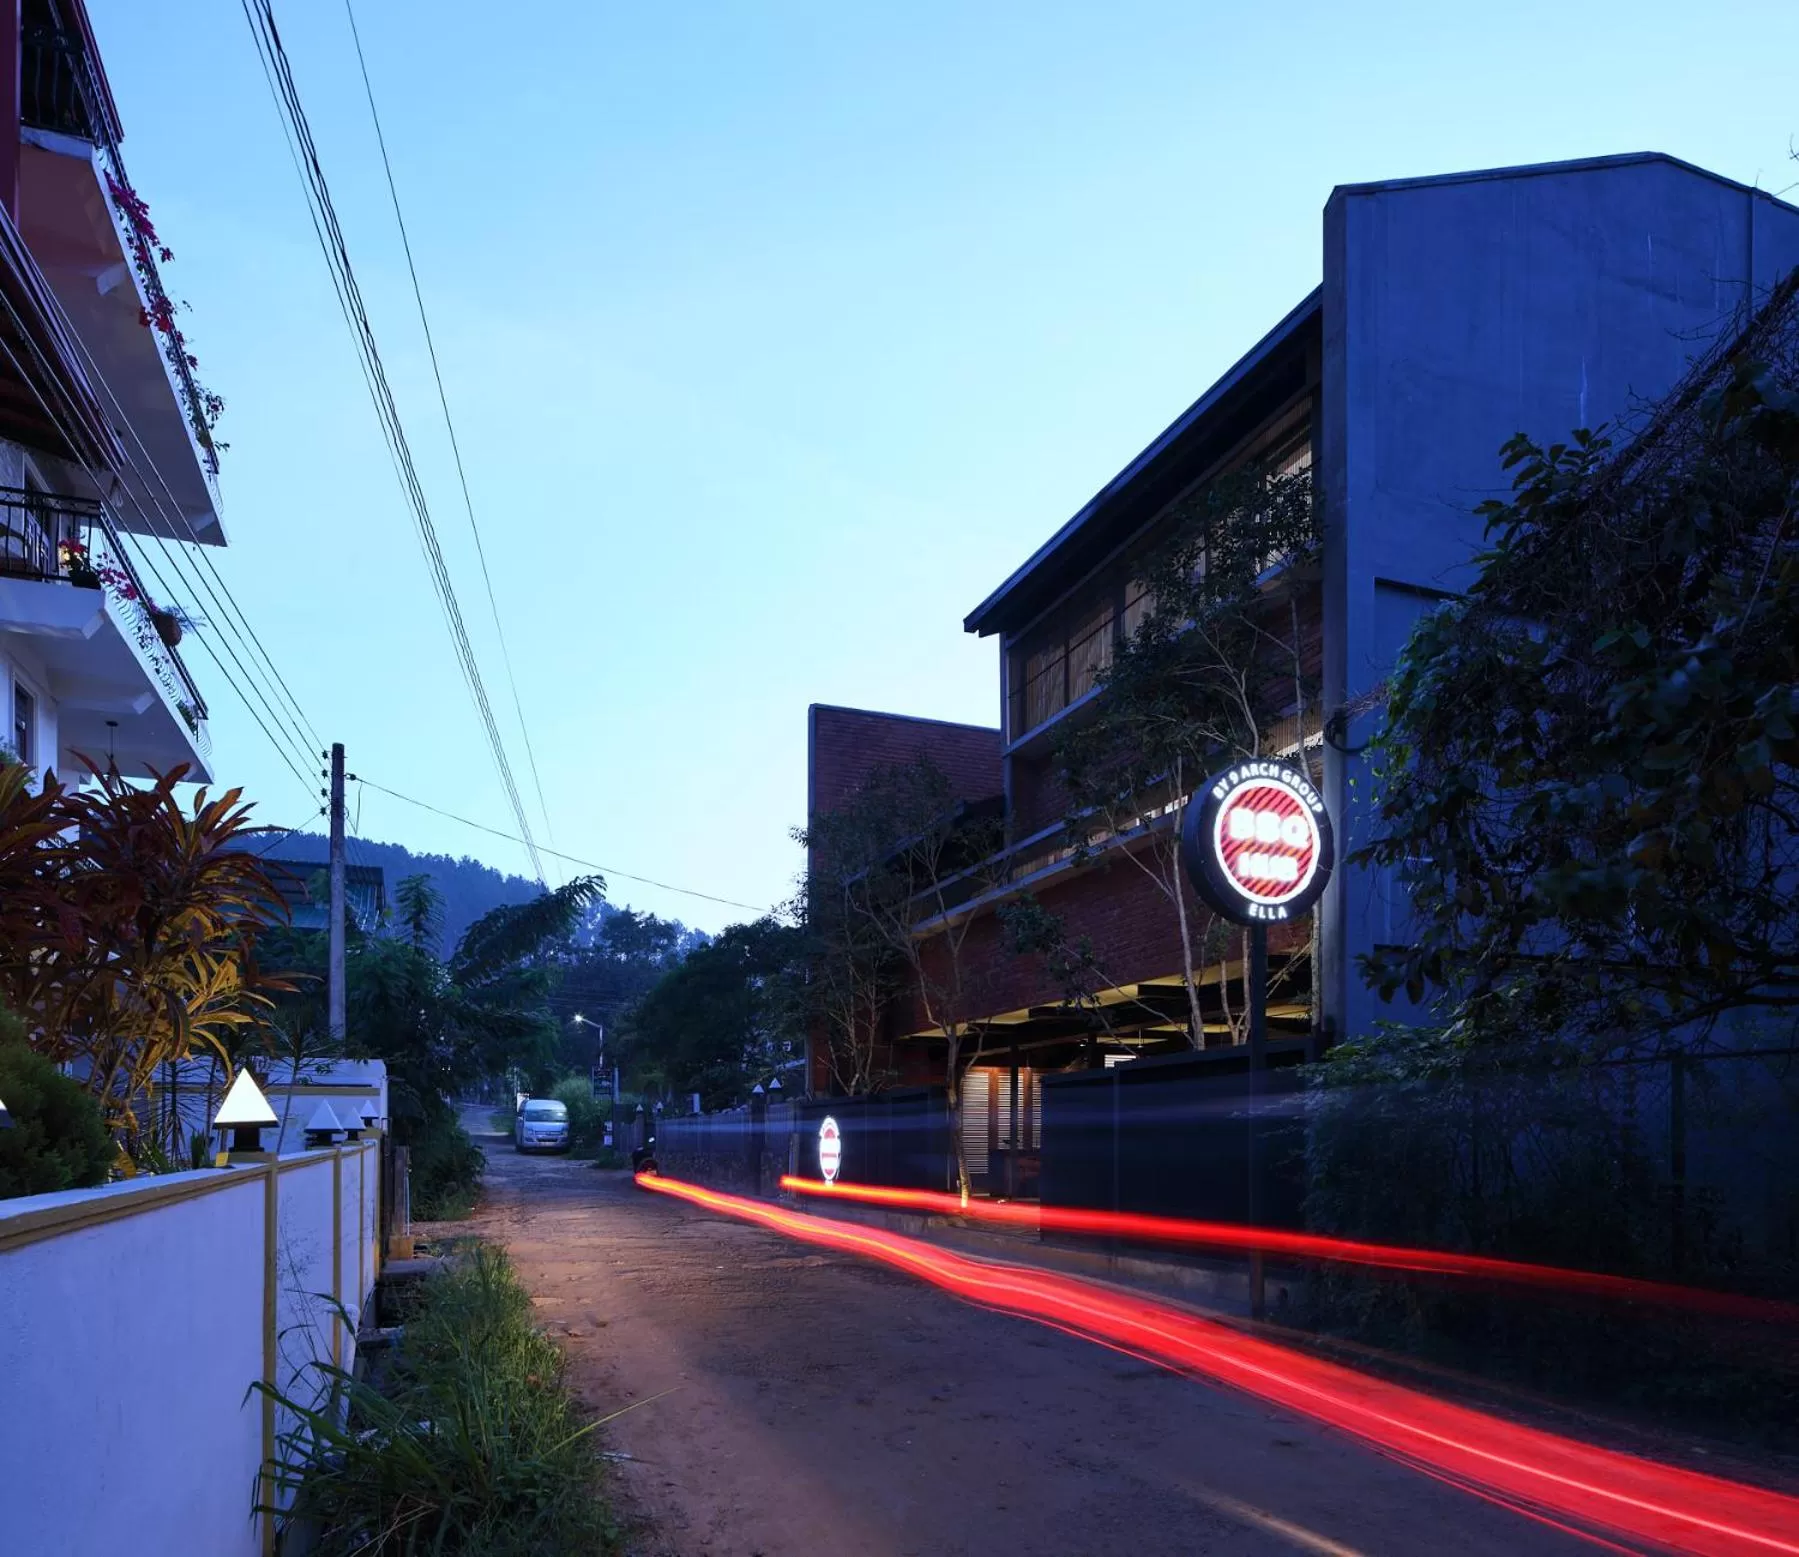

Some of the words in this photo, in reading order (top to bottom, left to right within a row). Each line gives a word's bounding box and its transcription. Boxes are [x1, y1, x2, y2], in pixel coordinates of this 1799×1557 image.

[1212, 777, 1230, 800] BY
[1229, 771, 1239, 785] 9
[1241, 763, 1280, 779] ARCH
[1281, 770, 1324, 813] GROUP
[1230, 808, 1309, 848] BBQ
[1248, 904, 1288, 920] ELLA
